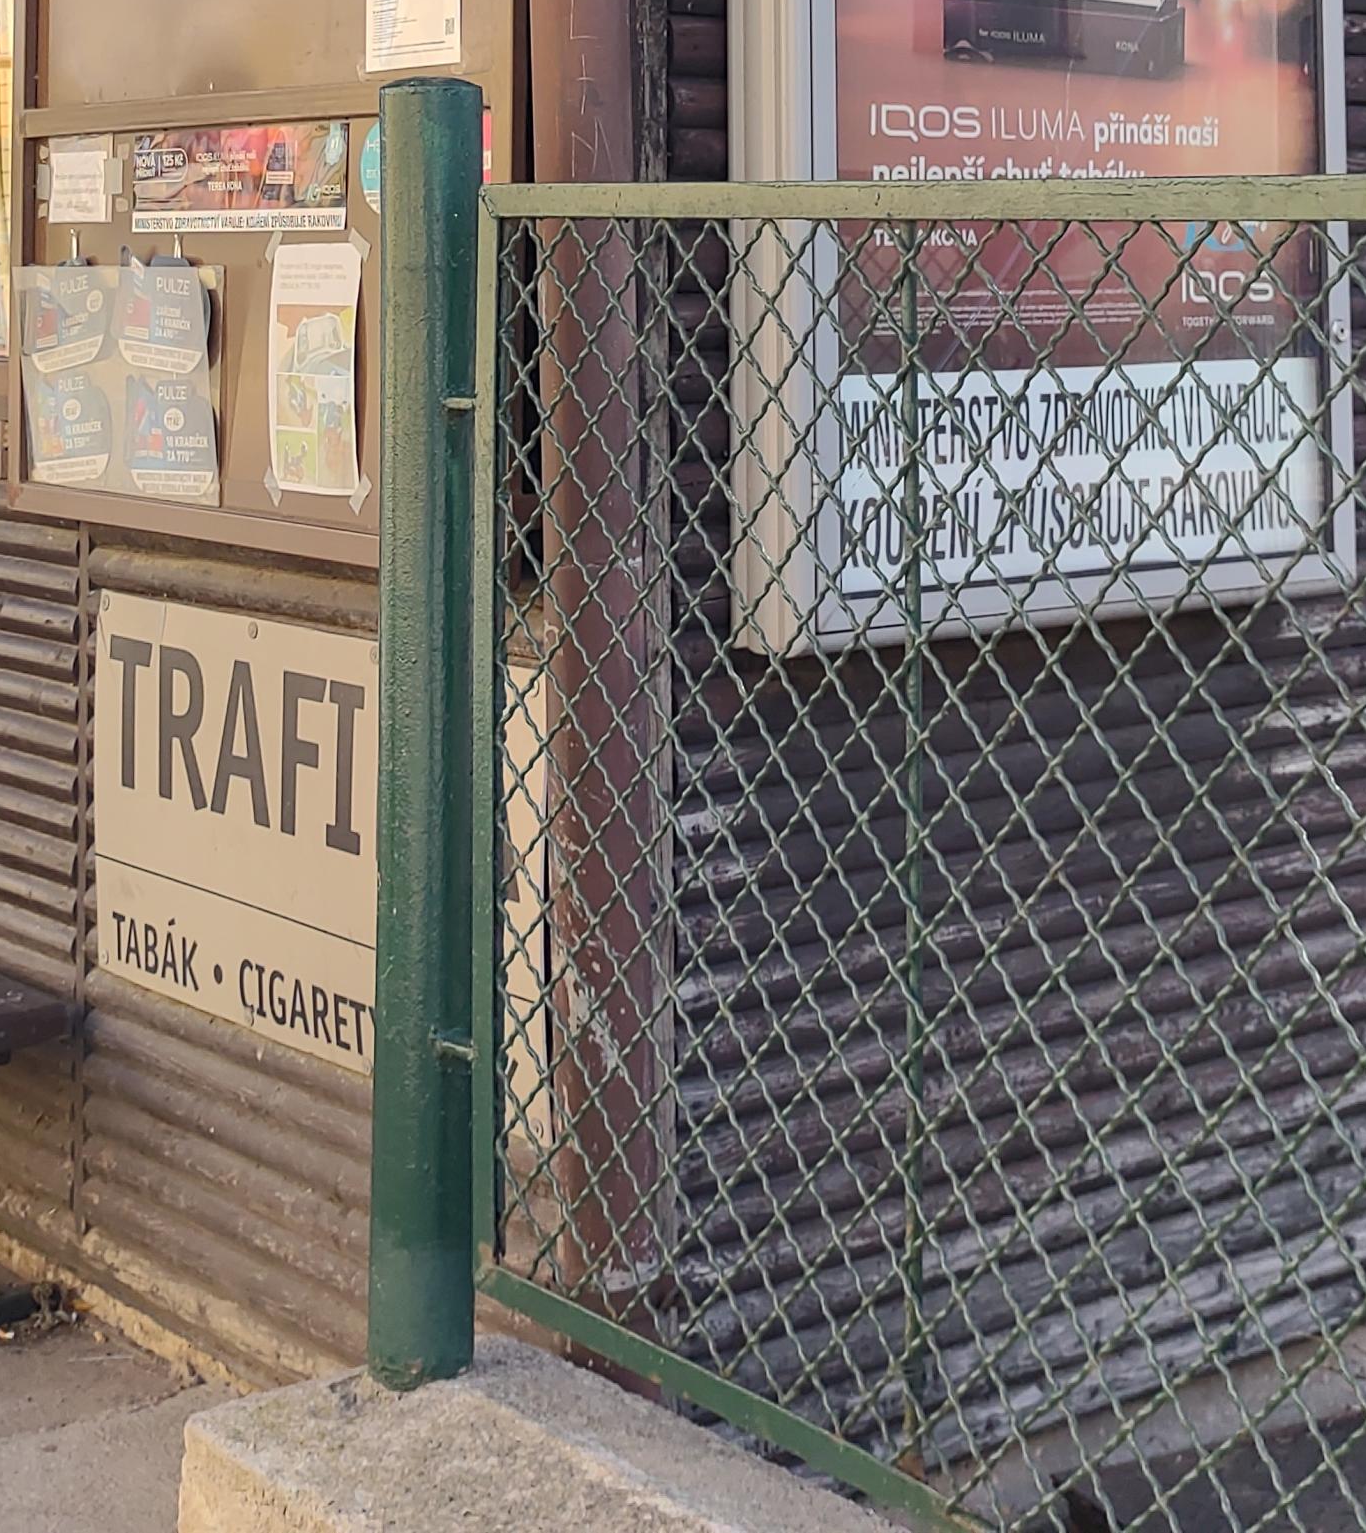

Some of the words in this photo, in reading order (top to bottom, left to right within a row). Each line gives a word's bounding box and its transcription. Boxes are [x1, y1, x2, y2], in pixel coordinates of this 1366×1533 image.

[1012, 30, 1046, 44] ILUMA
[870, 103, 981, 142] IQOS
[991, 107, 1085, 141] ILUMA
[1094, 112, 1171, 152] přináší
[1175, 116, 1218, 147] naši
[156, 276, 191, 296] PULZE
[58, 376, 84, 393] PULZE
[158, 386, 188, 400] PULZE
[840, 394, 1031, 470] MINITERSTVO
[110, 634, 365, 856] TRAFI
[112, 911, 199, 992] TABÁK
